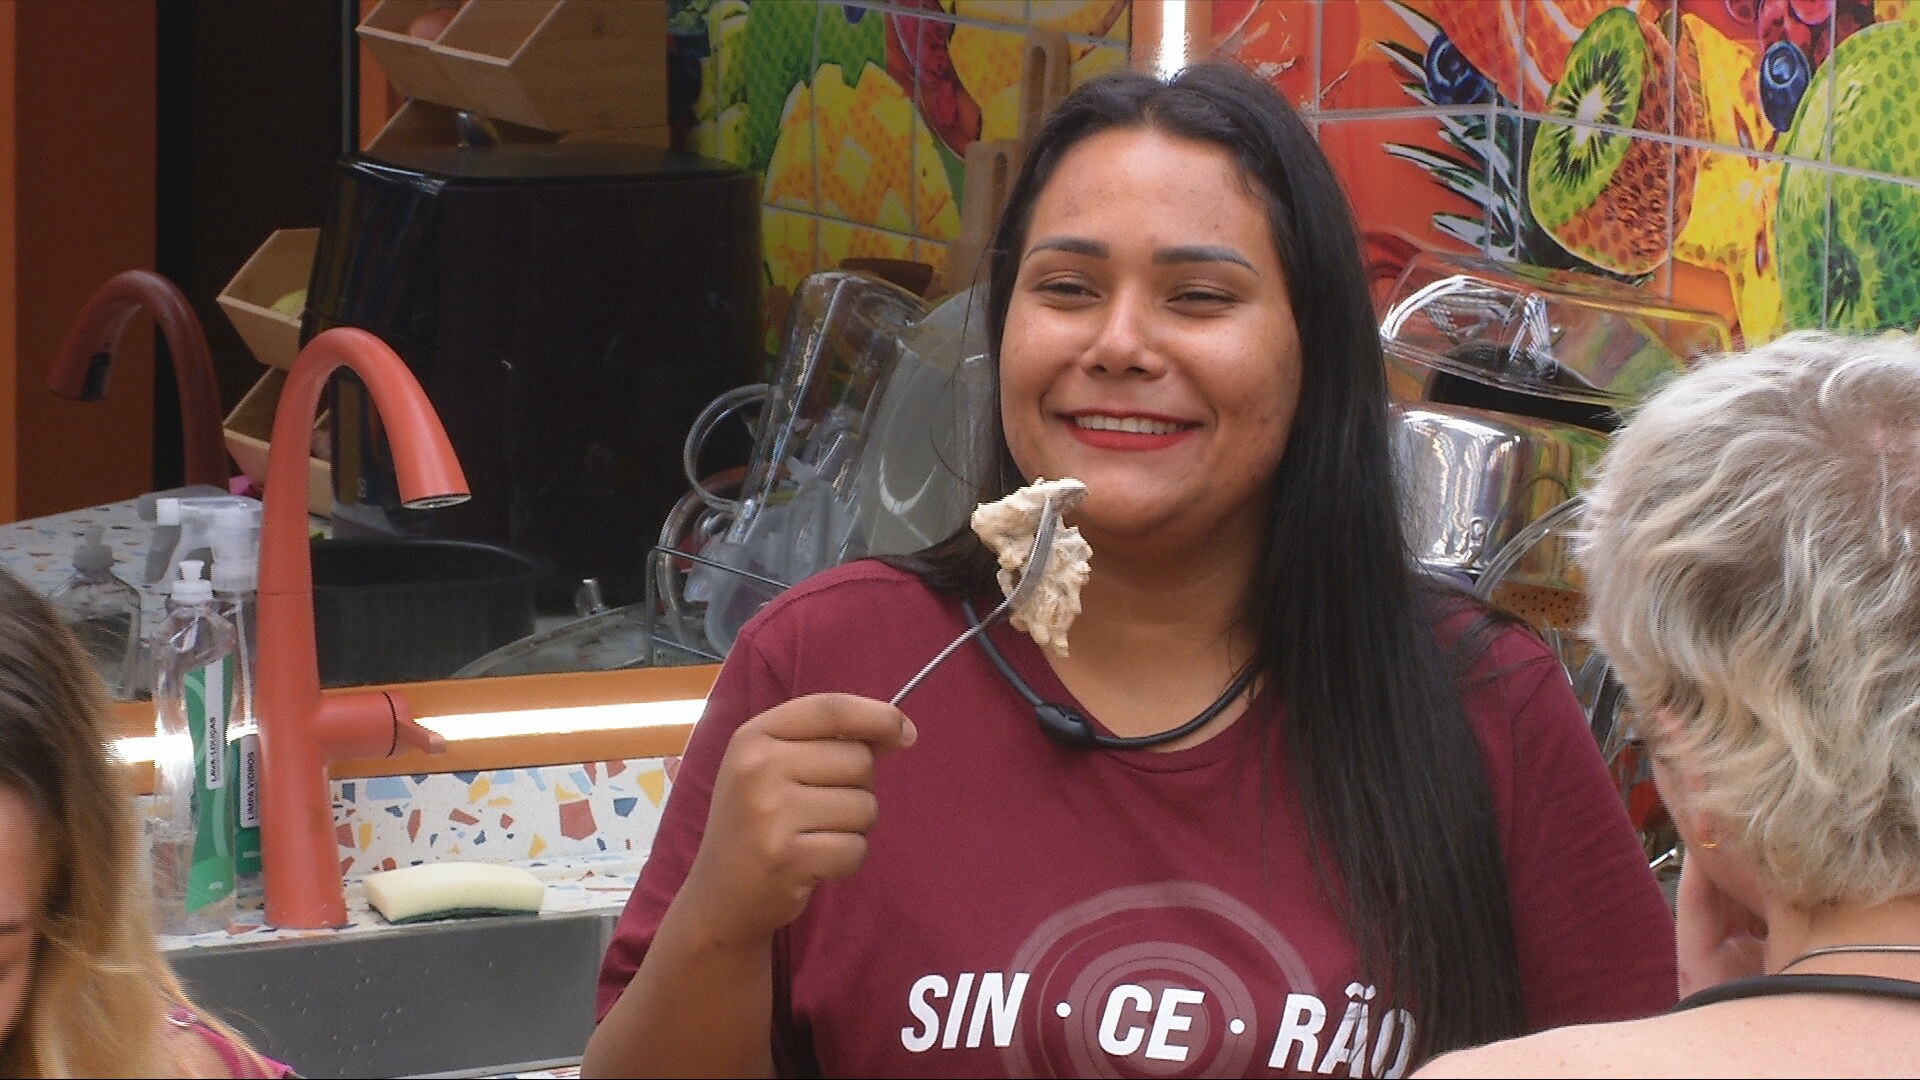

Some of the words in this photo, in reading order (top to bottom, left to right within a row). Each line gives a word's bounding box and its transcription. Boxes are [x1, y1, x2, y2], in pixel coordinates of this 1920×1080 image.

[901, 972, 1031, 1053] SIN
[1097, 983, 1206, 1062] CE
[1268, 981, 1417, 1079] RÃO
